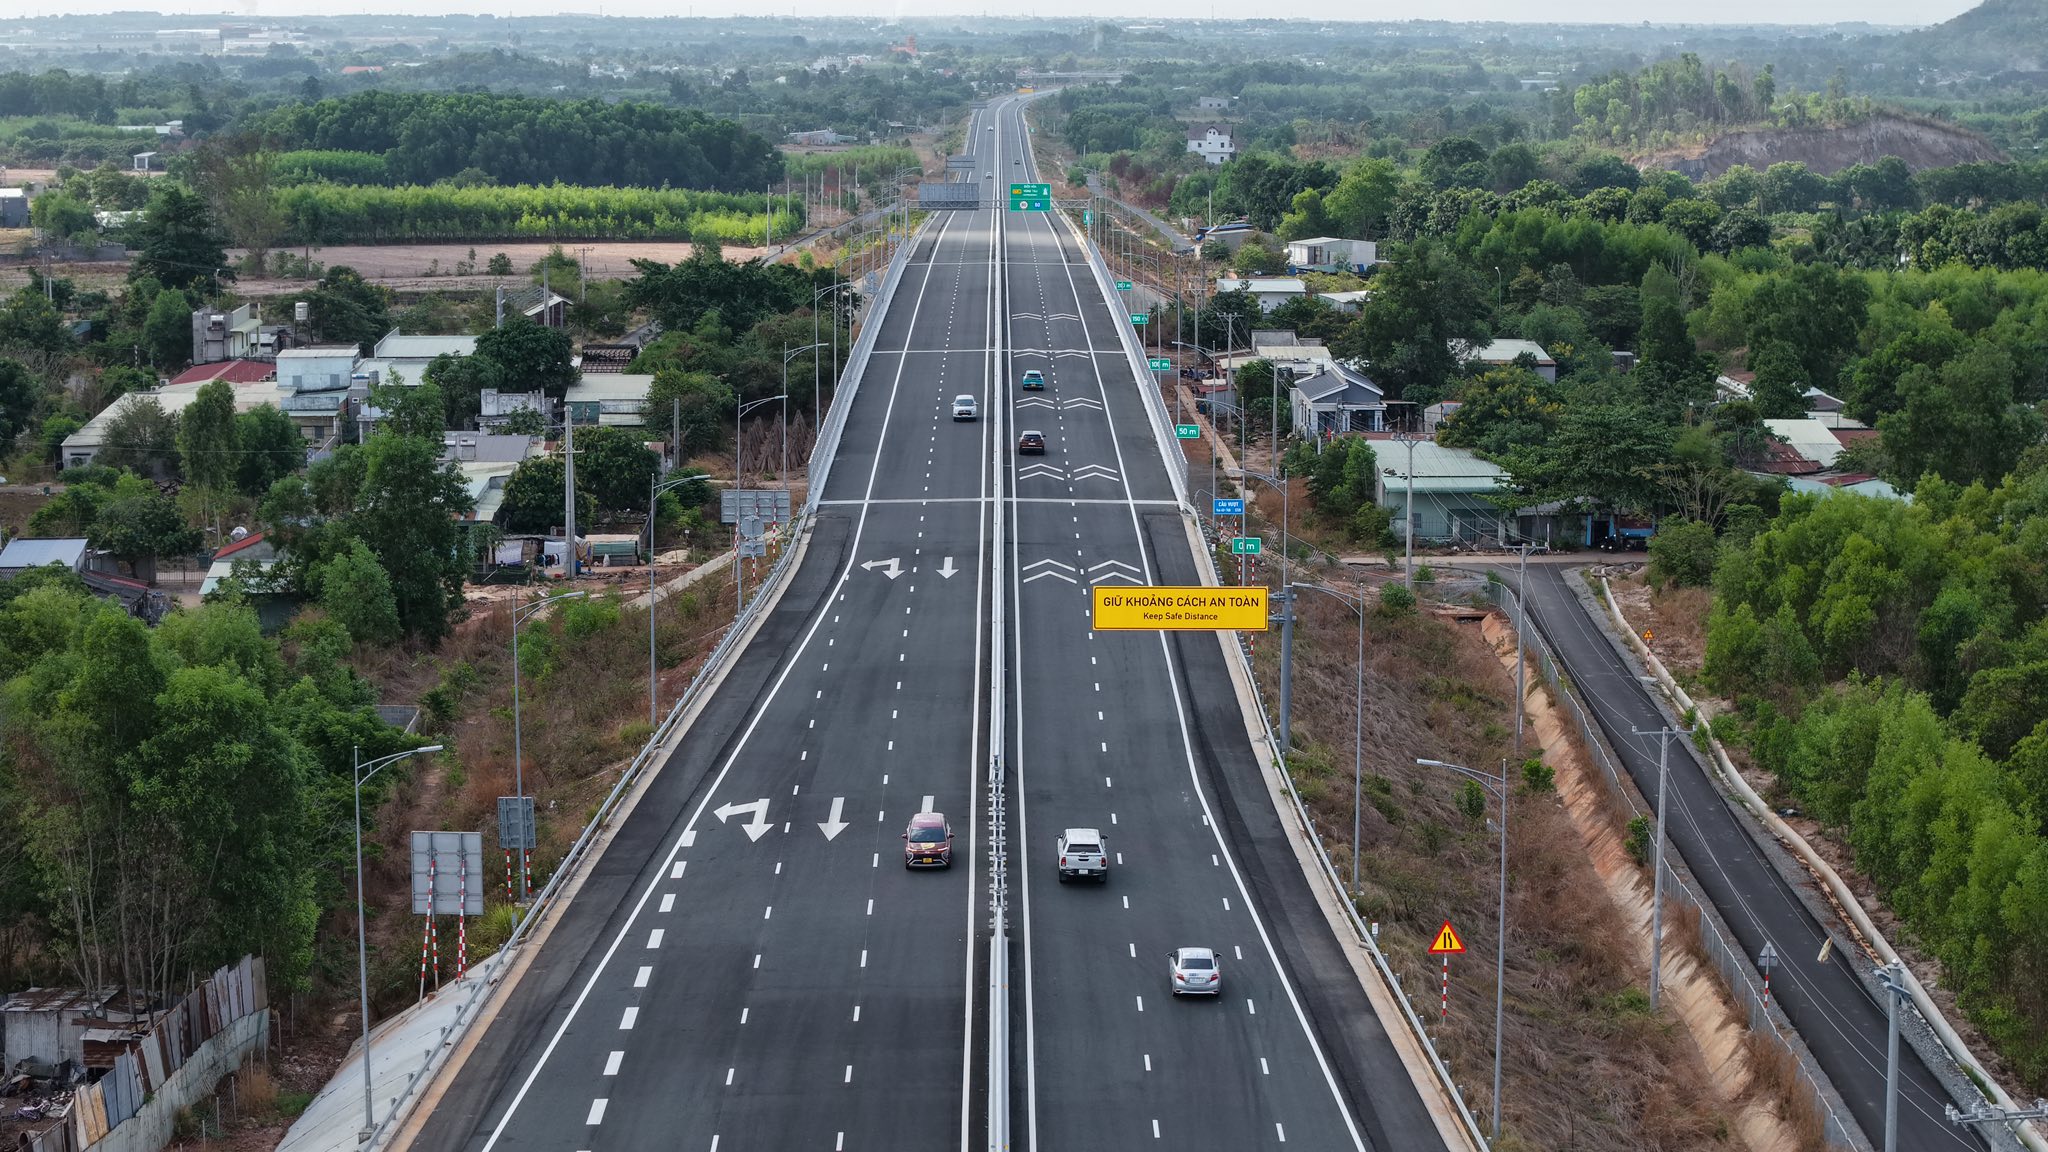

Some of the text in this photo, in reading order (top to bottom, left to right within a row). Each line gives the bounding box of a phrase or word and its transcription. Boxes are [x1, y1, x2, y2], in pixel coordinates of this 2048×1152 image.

[1179, 427, 1188, 435] 50
[1103, 594, 1259, 607] GIỮ KHOẢNG CÁCH AN TOÀN
[1143, 612, 1218, 621] Keep Safe Distance
